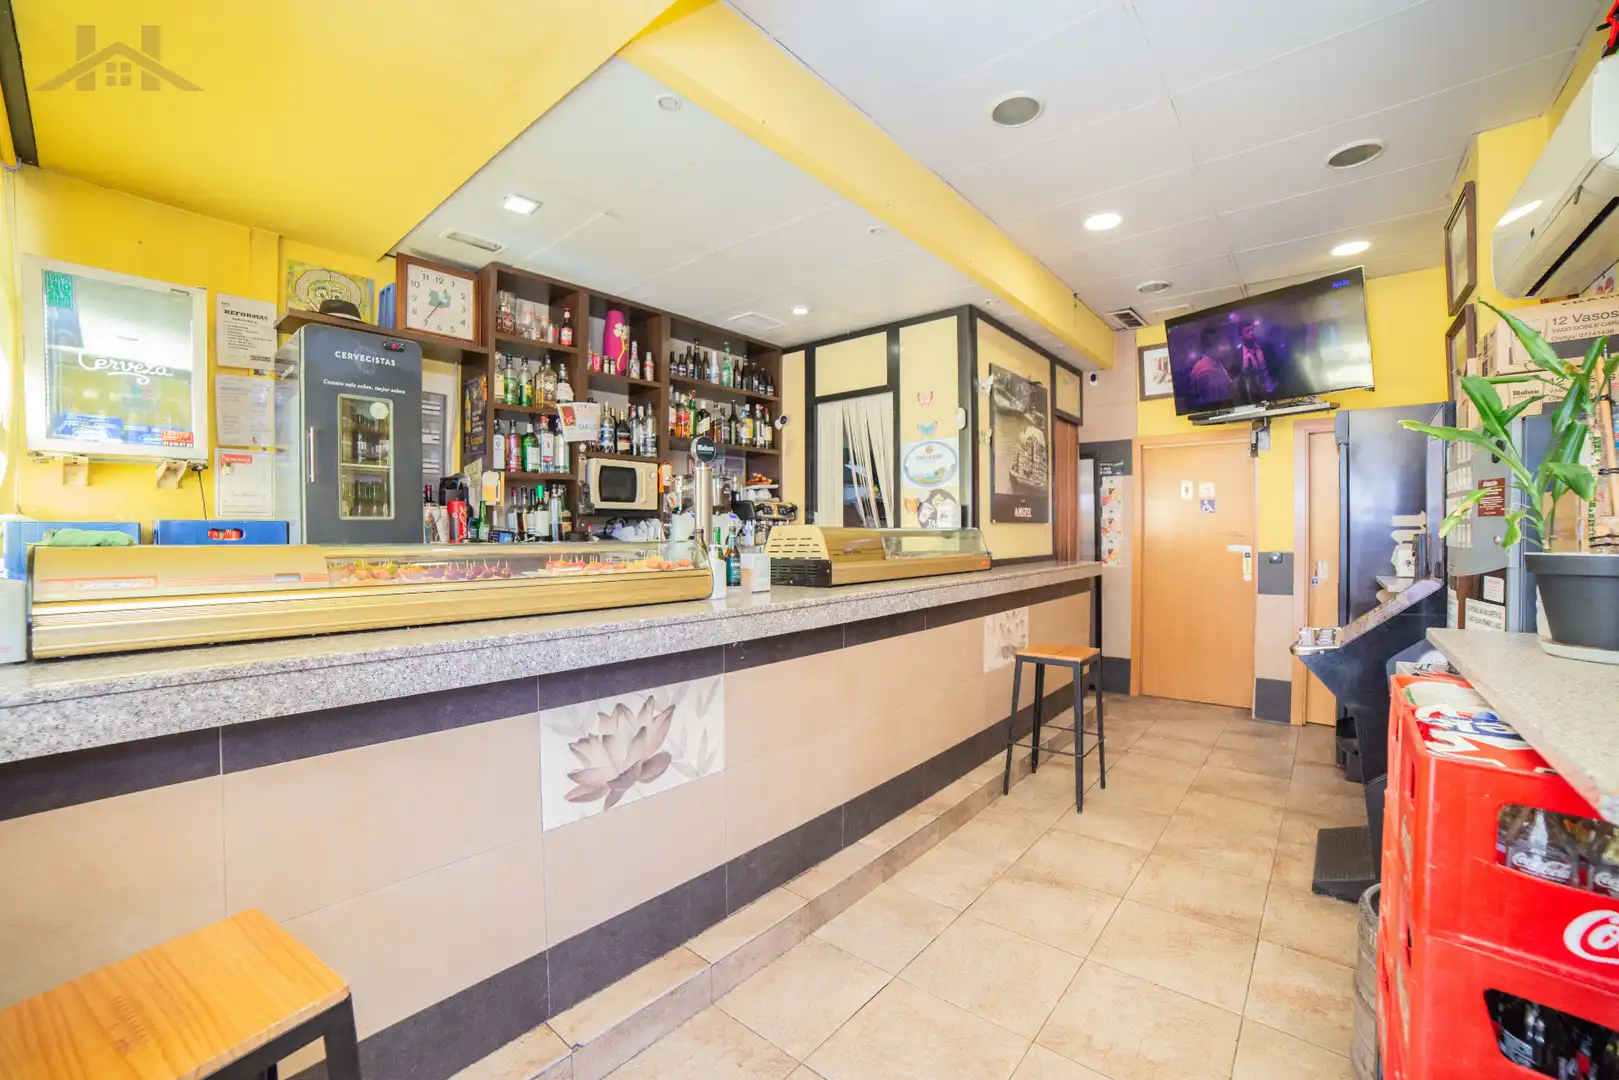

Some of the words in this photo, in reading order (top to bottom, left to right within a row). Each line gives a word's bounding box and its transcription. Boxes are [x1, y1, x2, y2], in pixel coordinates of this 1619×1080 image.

[411, 280, 420, 288] 10
[435, 276, 444, 284] 12
[460, 306, 467, 314] 3
[1551, 316, 1568, 326] 12
[1572, 310, 1619, 323] Vasos
[334, 350, 396, 367] CERVECISTAS
[77, 351, 174, 385] Cerveza
[1014, 507, 1032, 517] AMSTEL
